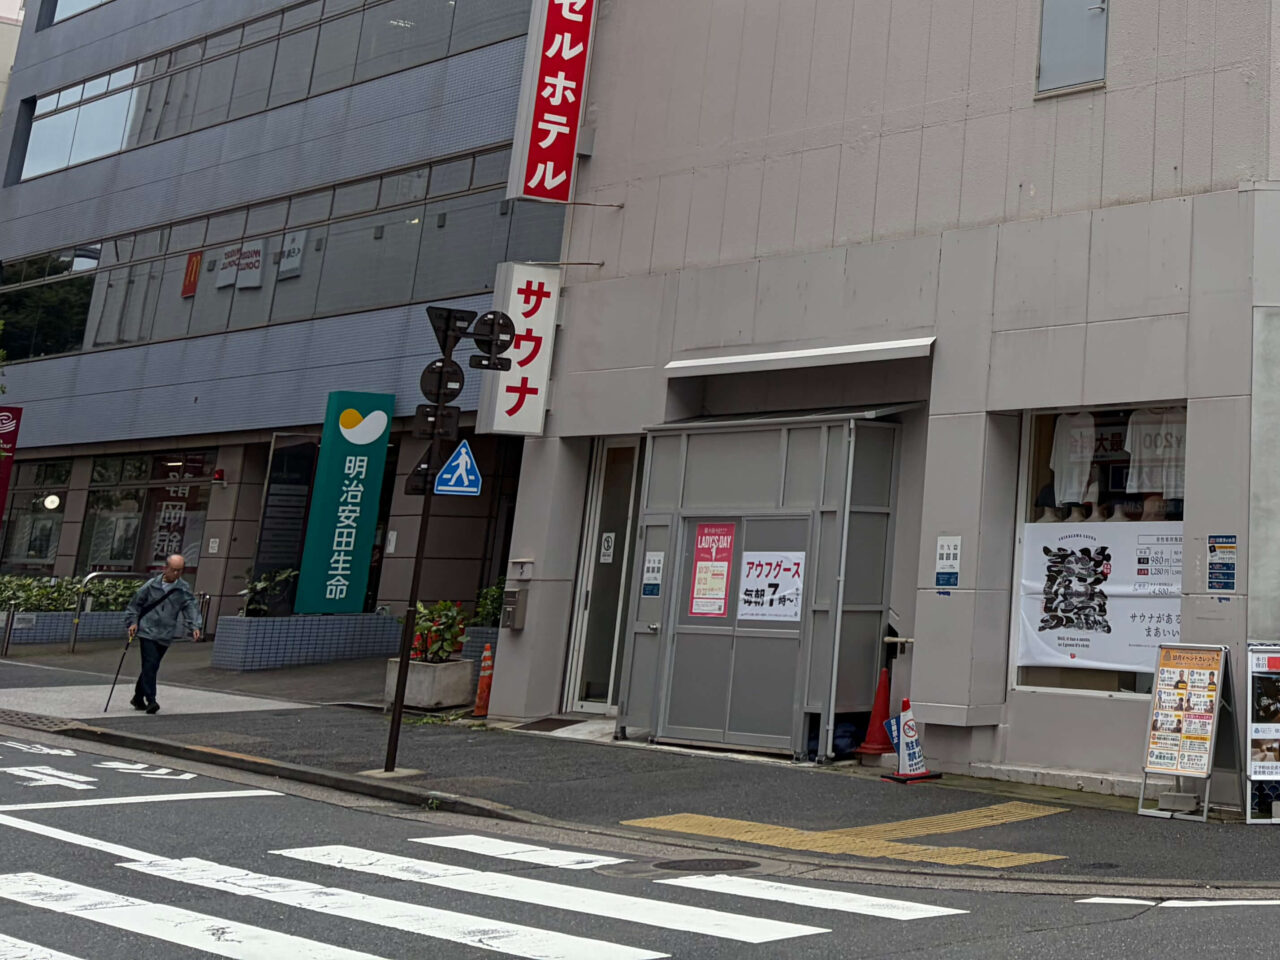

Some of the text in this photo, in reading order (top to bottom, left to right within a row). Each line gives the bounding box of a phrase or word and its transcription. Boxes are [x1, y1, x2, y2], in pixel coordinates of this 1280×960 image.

[504, 279, 552, 417] サウナ
[325, 455, 369, 600] 明治安田生命
[745, 559, 801, 579] アウフグース
